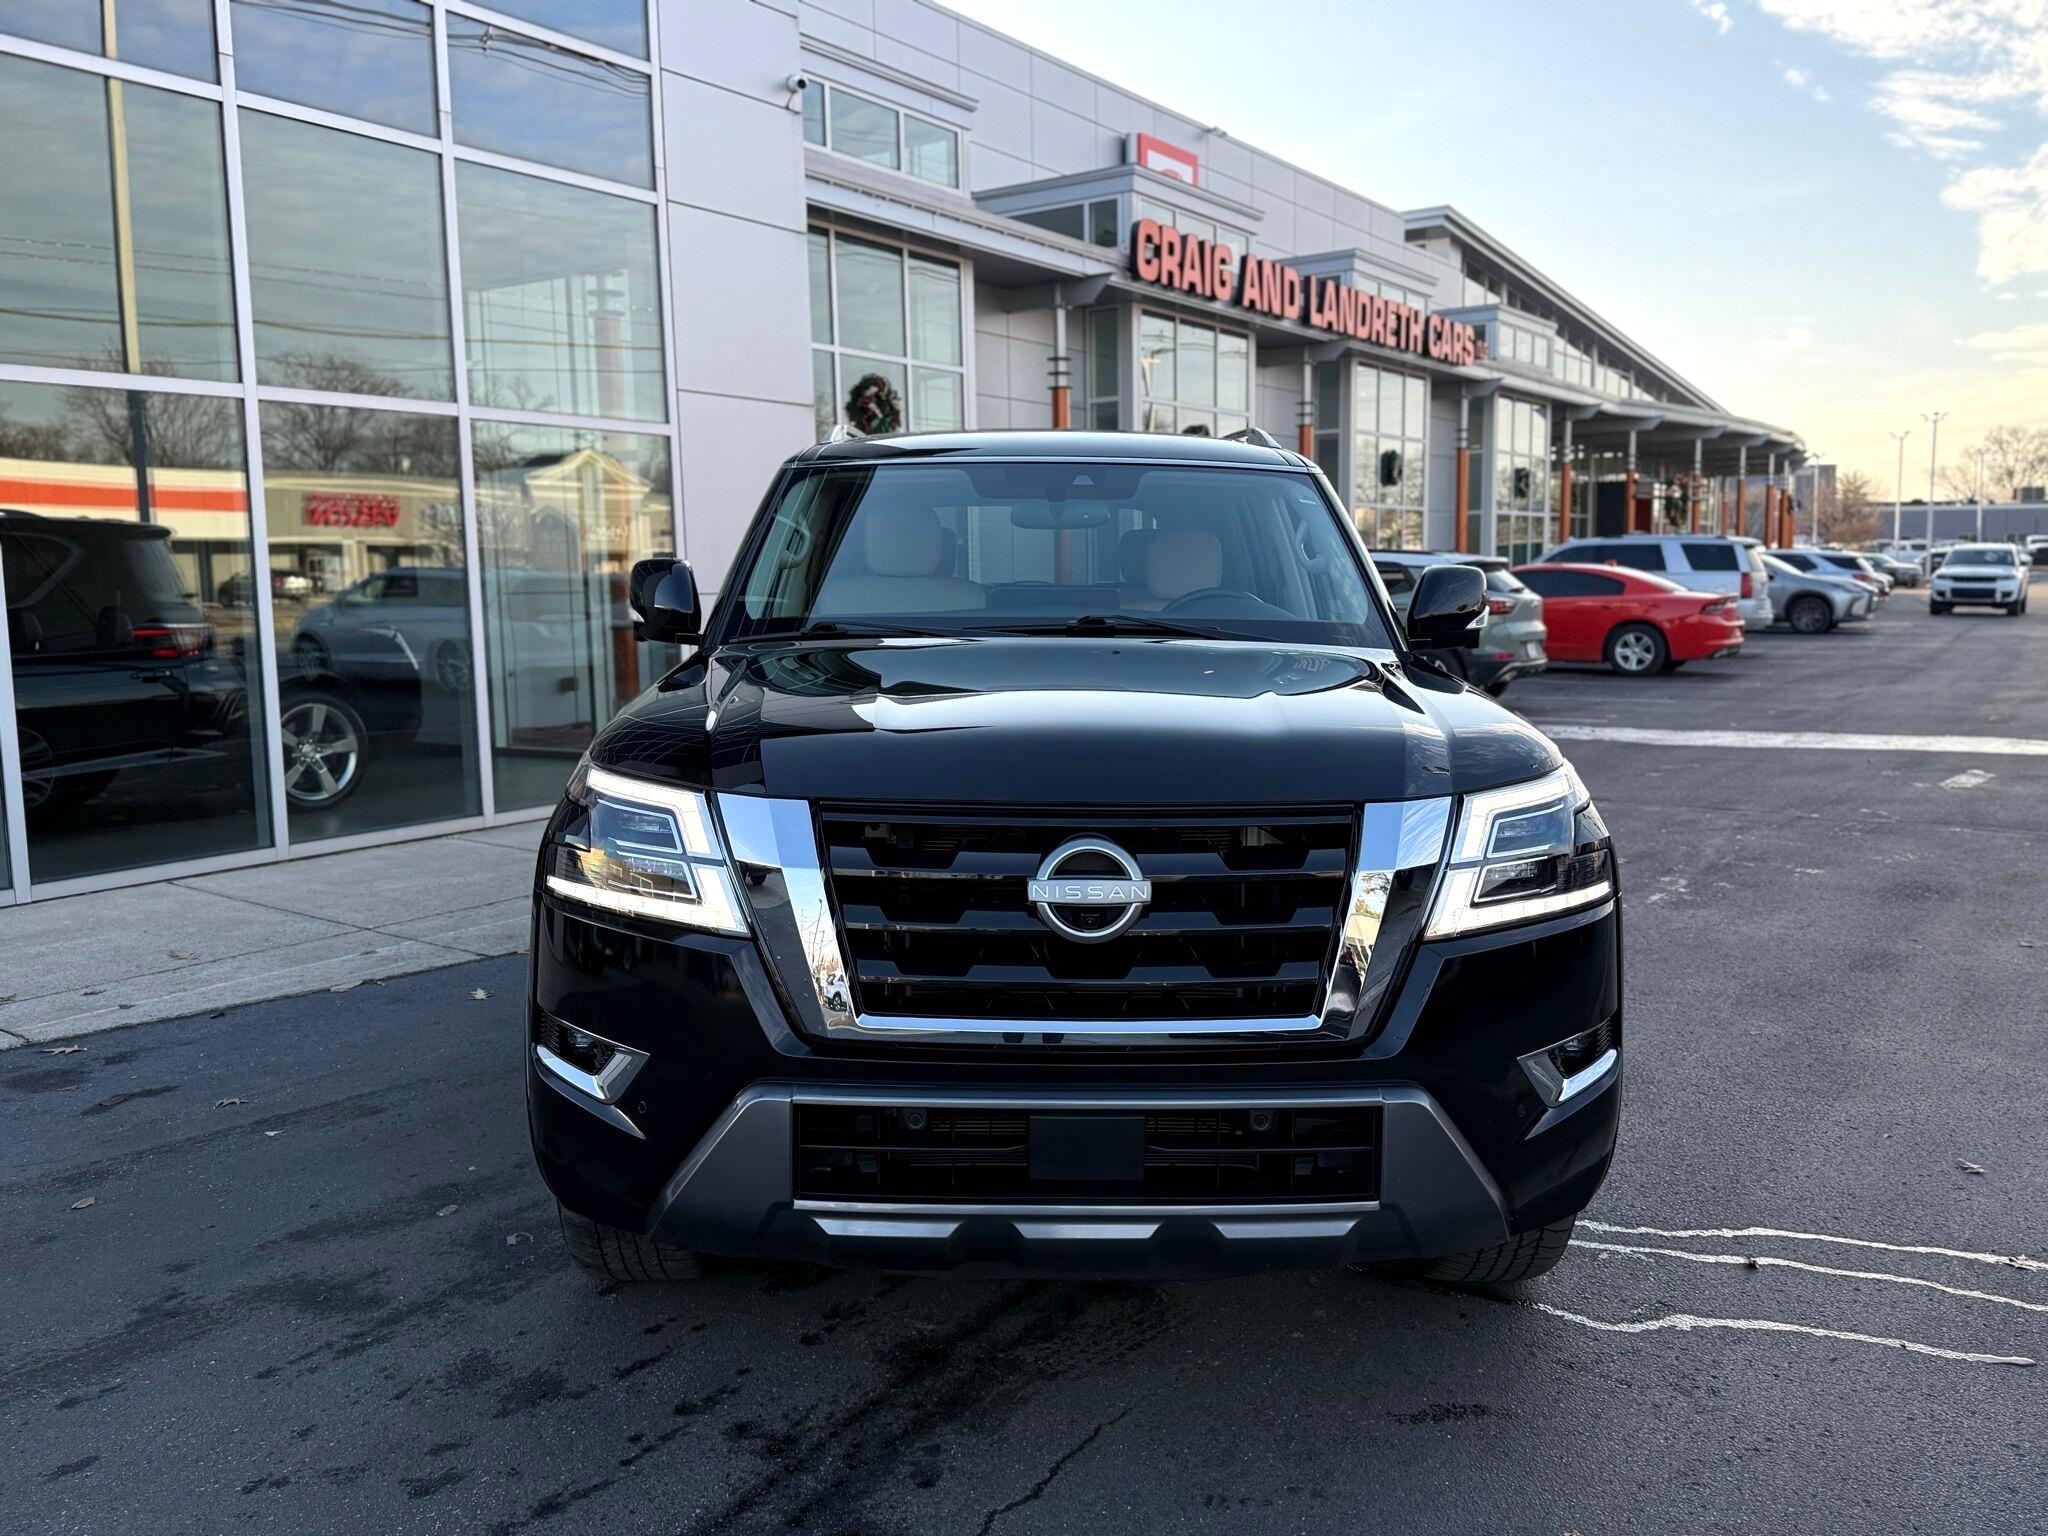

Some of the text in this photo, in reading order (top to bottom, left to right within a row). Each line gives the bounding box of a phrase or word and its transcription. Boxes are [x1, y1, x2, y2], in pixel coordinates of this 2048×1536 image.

[1135, 218, 1476, 367] CRAIG AND LANDRETH CARS
[1031, 884, 1148, 900] NISSAN
